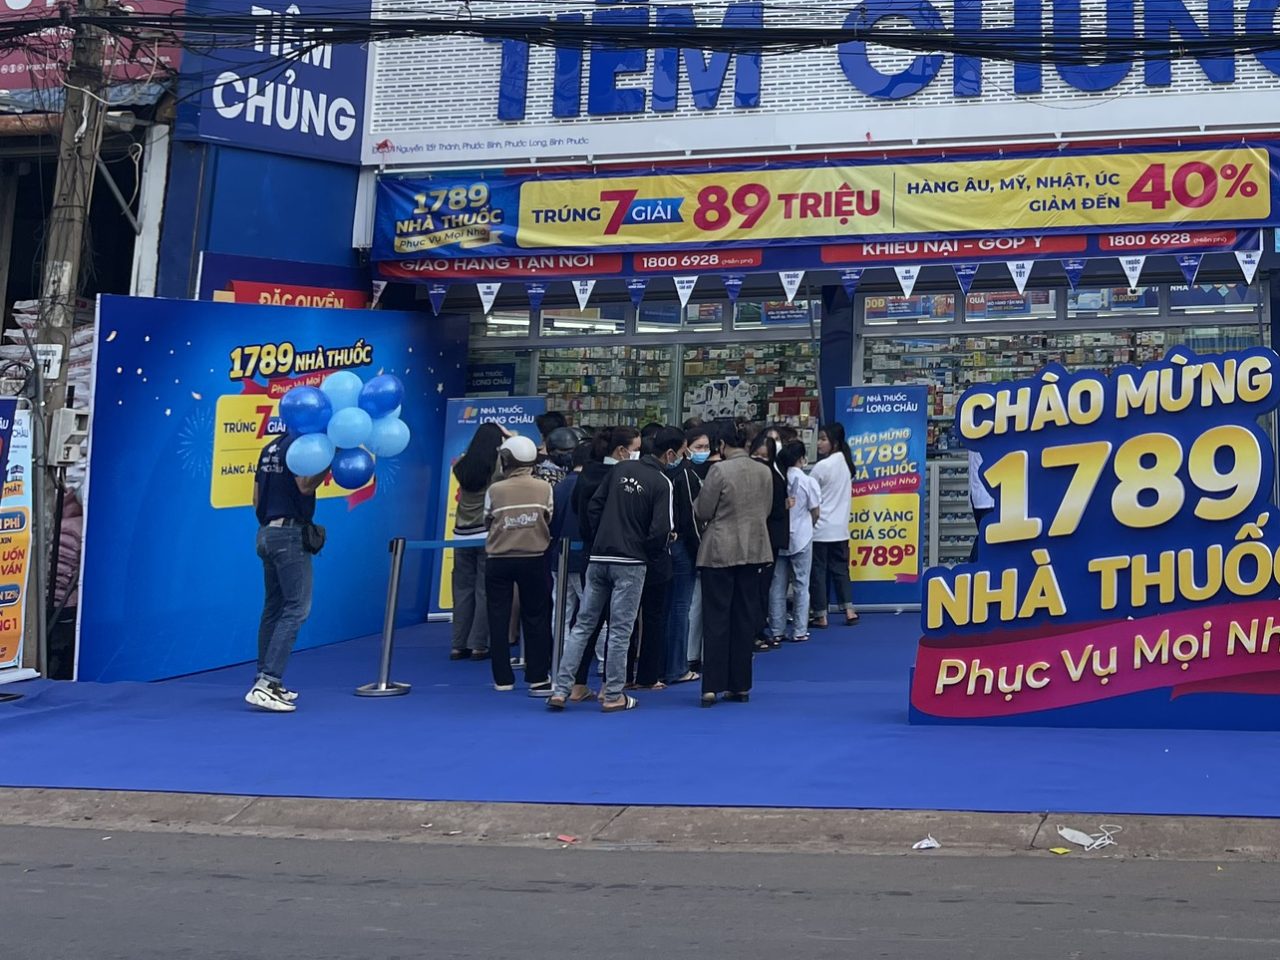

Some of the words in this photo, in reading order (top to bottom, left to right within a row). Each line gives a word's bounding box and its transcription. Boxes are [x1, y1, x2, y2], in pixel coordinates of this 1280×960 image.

[212, 68, 357, 141] CHỦNG
[906, 177, 959, 196] HÀNG
[963, 174, 995, 194] ÂU,
[999, 171, 1032, 192] MỸ,
[1036, 170, 1090, 190] NHẬT,
[1095, 167, 1120, 187] ÚC
[1126, 160, 1259, 211] 40%
[413, 181, 489, 214] 1789
[531, 202, 601, 225] TRÚNG
[600, 188, 639, 236] 7
[631, 199, 672, 222] GIẢI
[693, 182, 769, 232] 89
[777, 182, 881, 225] TRIỆU
[1029, 194, 1077, 212] GIẢM
[1080, 190, 1121, 209] ĐẾN
[396, 214, 435, 234] NHÀ
[441, 204, 502, 228] THUỐC
[923, 240, 958, 256] NẠI
[1108, 234, 1145, 247] 1800
[1150, 232, 1191, 245] 6928
[400, 259, 449, 271] GIAO
[642, 255, 677, 268] 1800
[681, 254, 719, 266] 6928
[229, 342, 294, 379] 1789
[294, 347, 325, 372] NHÀ
[327, 339, 372, 365] THUỐC
[866, 393, 882, 403] NHÀ
[883, 392, 907, 402] THUỐC
[866, 404, 892, 413] LONG
[893, 401, 918, 412] CHÂU
[958, 370, 1105, 440] CHÀO
[1115, 353, 1273, 419] MỪNG
[480, 406, 496, 414] NHÀ
[498, 405, 523, 414] THUỐC
[508, 413, 534, 424] CHÂU
[223, 418, 257, 433] TRÚNG
[255, 405, 274, 440] 7
[853, 442, 907, 466] 1789
[221, 462, 245, 475] HÀNG
[873, 457, 917, 478] THUỐC
[983, 424, 1263, 545] 1789
[873, 507, 914, 522] VÀNG
[849, 525, 875, 540] GIÁ
[877, 523, 908, 540] SỐC
[926, 548, 1067, 630] NHÀ
[934, 657, 1051, 702] Phục
[1060, 644, 1118, 686] Vụ
[1133, 621, 1212, 671] Mọi
